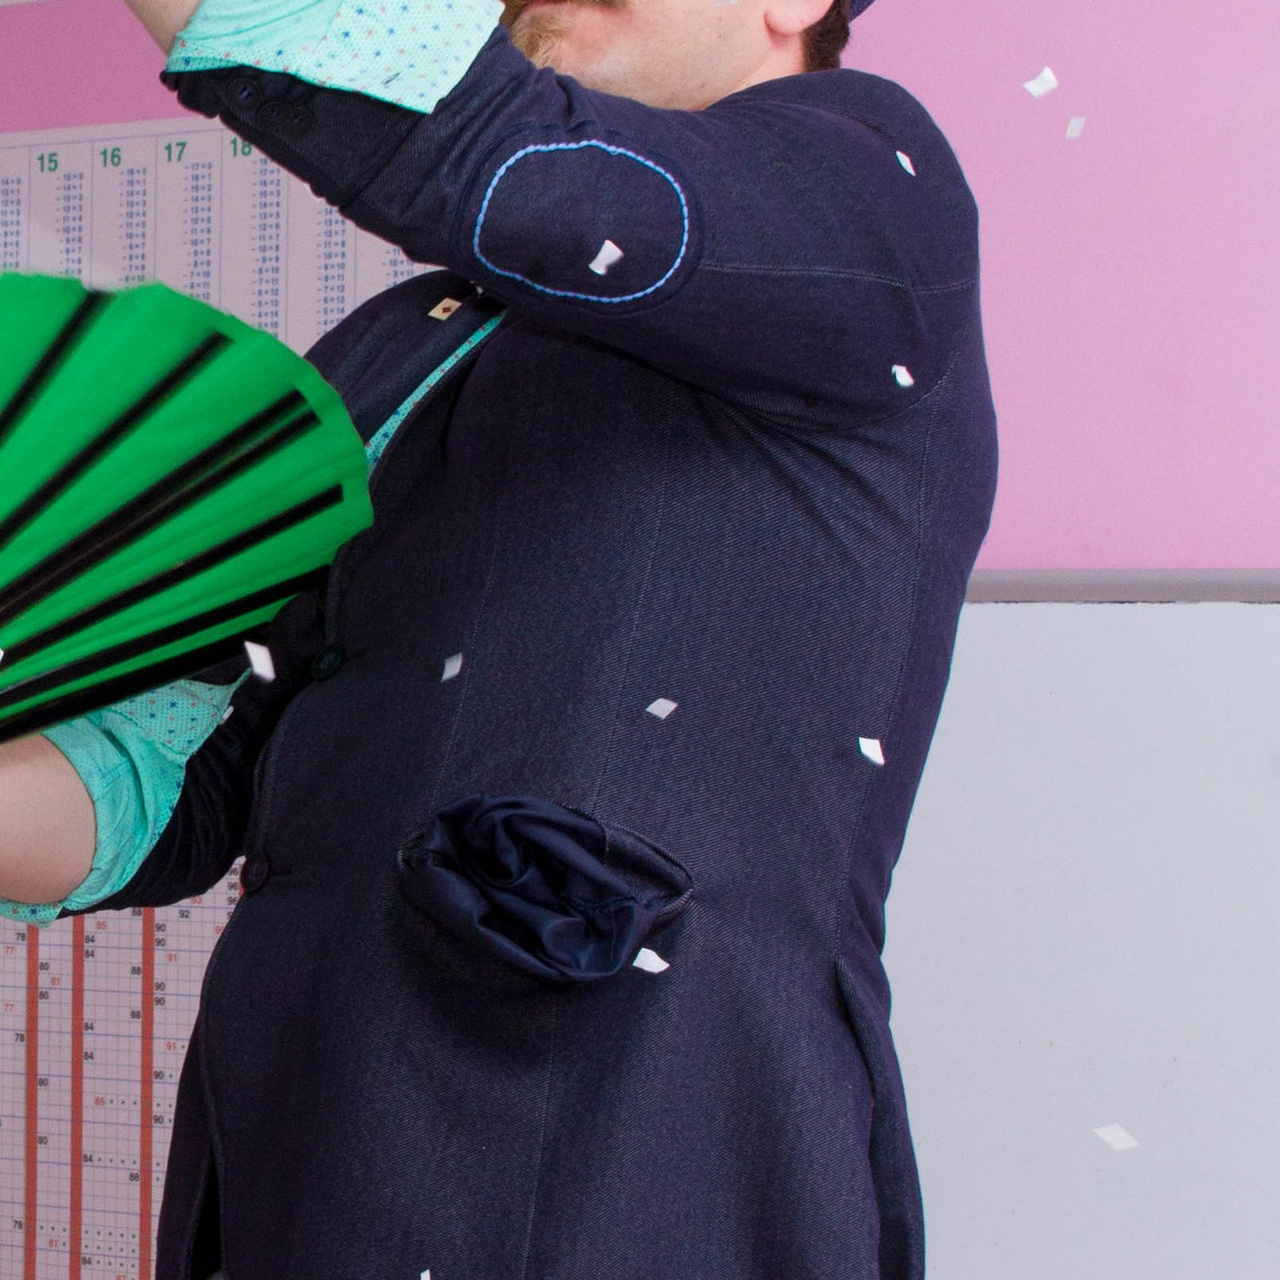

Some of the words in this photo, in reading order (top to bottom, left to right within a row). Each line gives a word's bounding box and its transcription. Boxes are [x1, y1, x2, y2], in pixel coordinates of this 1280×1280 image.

[37, 152, 58, 173] 15
[100, 147, 121, 168] 16
[164, 142, 186, 163] 17
[230, 137, 252, 157] 18
[179, 909, 190, 919] 92
[155, 923, 166, 933] 90
[16, 933, 26, 941] 78
[85, 935, 95, 944] 84
[5, 947, 15, 955] 77
[167, 953, 177, 962] 91
[39, 962, 49, 971] 80
[131, 966, 141, 976] 88
[155, 982, 165, 991] 90
